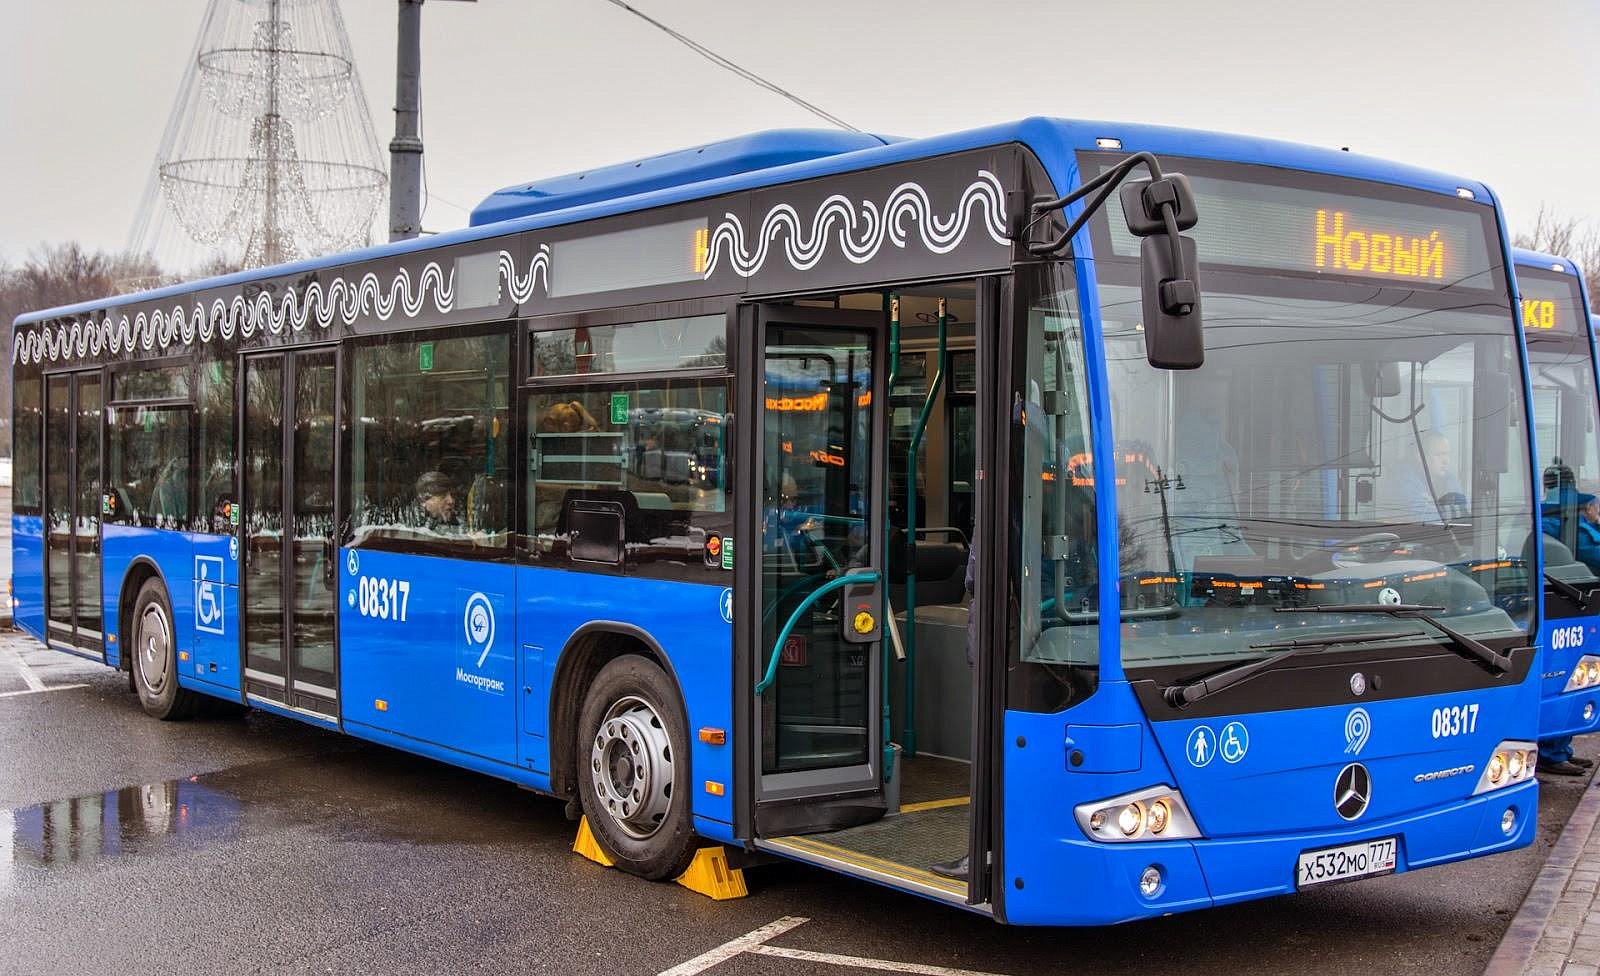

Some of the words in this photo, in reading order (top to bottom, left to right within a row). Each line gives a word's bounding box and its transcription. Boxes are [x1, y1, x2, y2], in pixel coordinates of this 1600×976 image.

[1315, 209, 1443, 278] Новый
[359, 575, 410, 622] 08317
[1552, 625, 1584, 650] 08163
[456, 667, 505, 691] Мосгортранс
[1432, 703, 1480, 739] 08317
[1414, 764, 1475, 783] CONECTO
